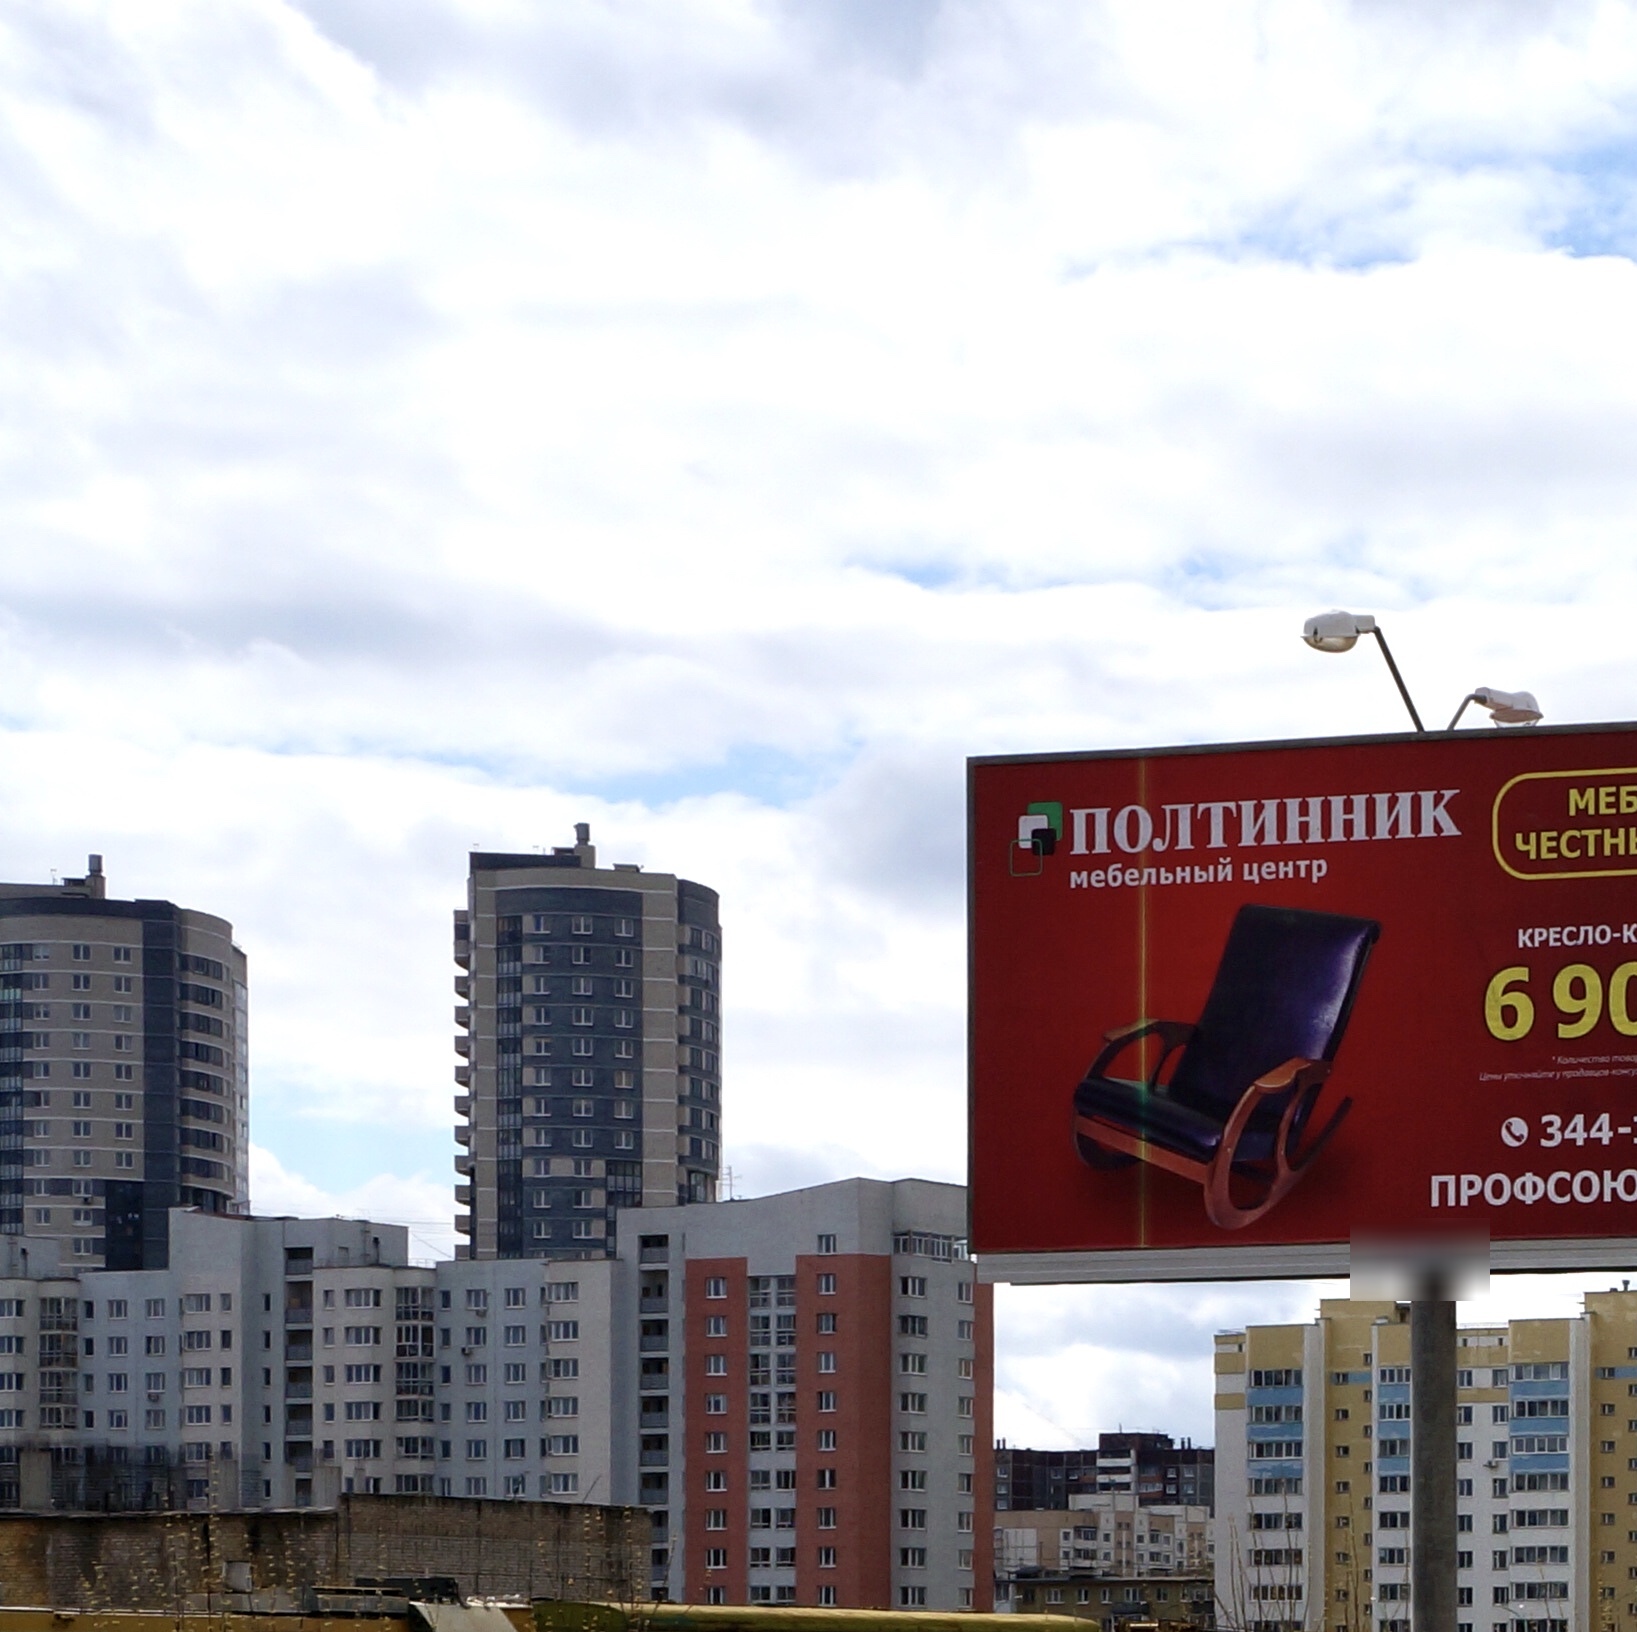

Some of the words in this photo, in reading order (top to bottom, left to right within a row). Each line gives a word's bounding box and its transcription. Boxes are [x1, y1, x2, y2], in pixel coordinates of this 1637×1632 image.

[1069, 788, 1462, 855] ПОЛТИННИК
[1070, 857, 1233, 889] мебельный
[1243, 857, 1328, 884] центр
